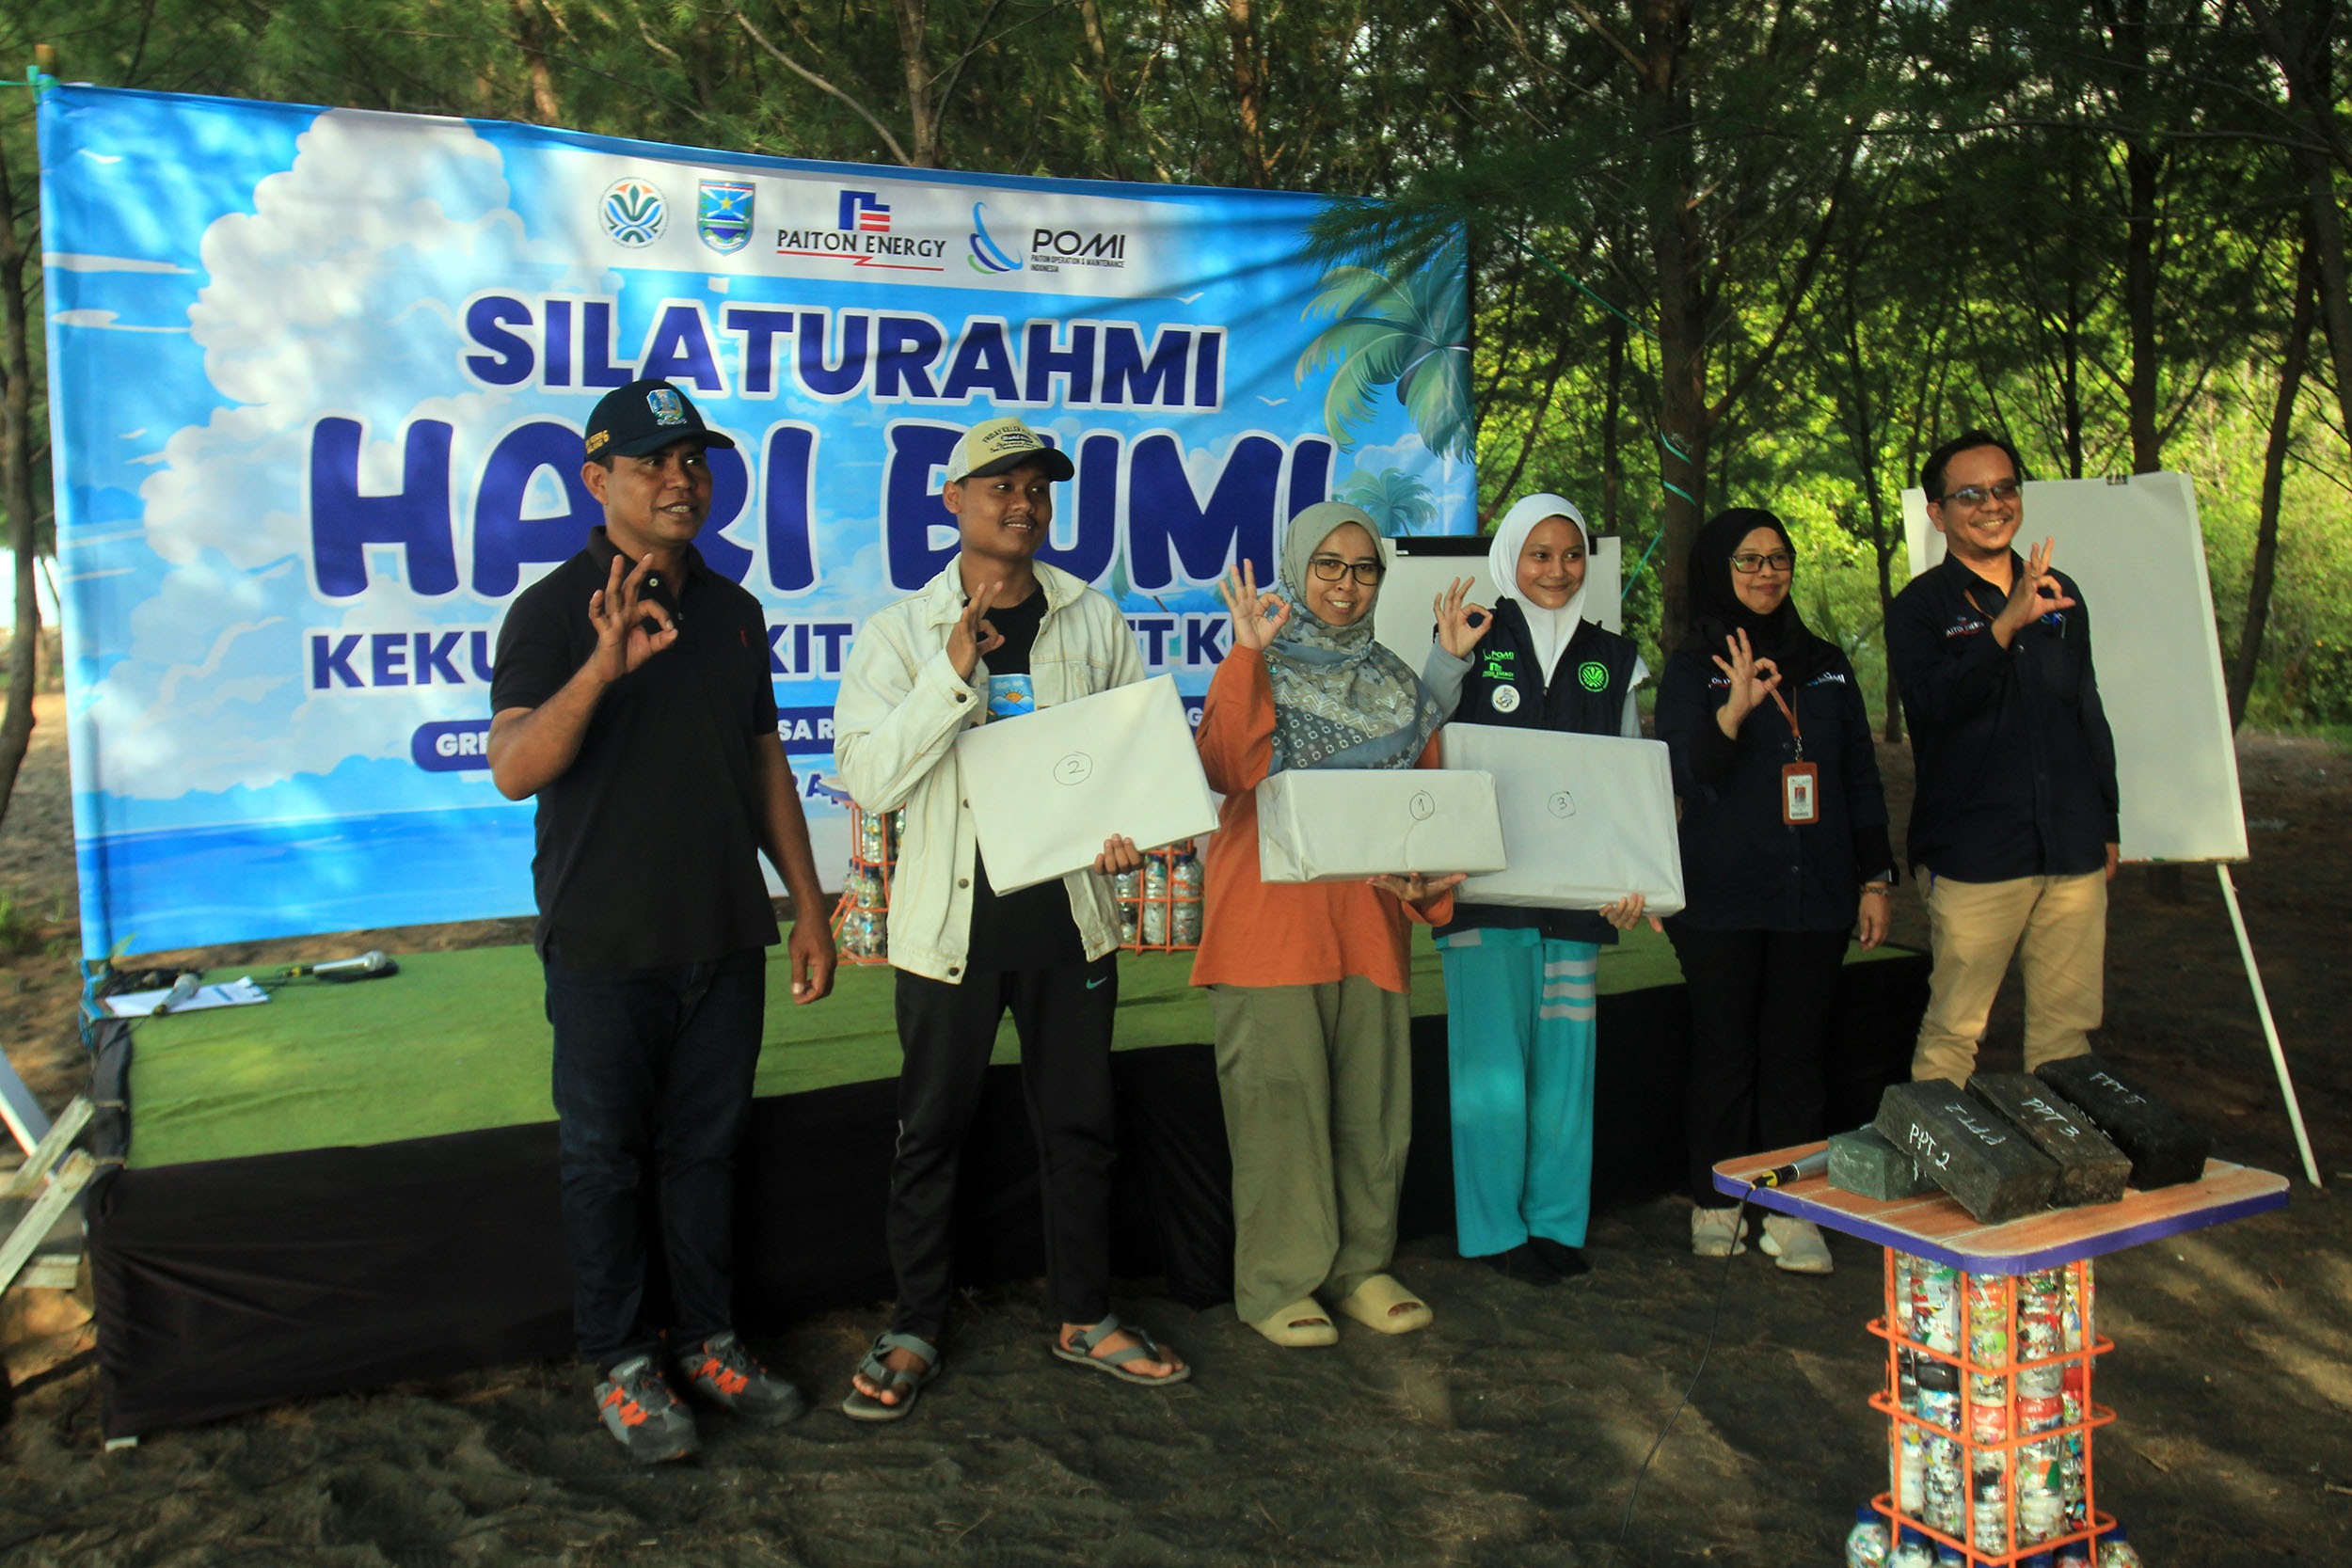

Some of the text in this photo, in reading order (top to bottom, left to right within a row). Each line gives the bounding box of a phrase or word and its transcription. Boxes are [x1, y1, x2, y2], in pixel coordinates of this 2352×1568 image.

[777, 230, 946, 258] PAITON ENERGY
[1032, 229, 1126, 259] POMI
[466, 295, 1221, 408] SILATURAHMI
[2021, 1098, 2069, 1122] PPT
[1909, 1123, 1937, 1156] PPT
[1935, 1151, 1950, 1171] 2
